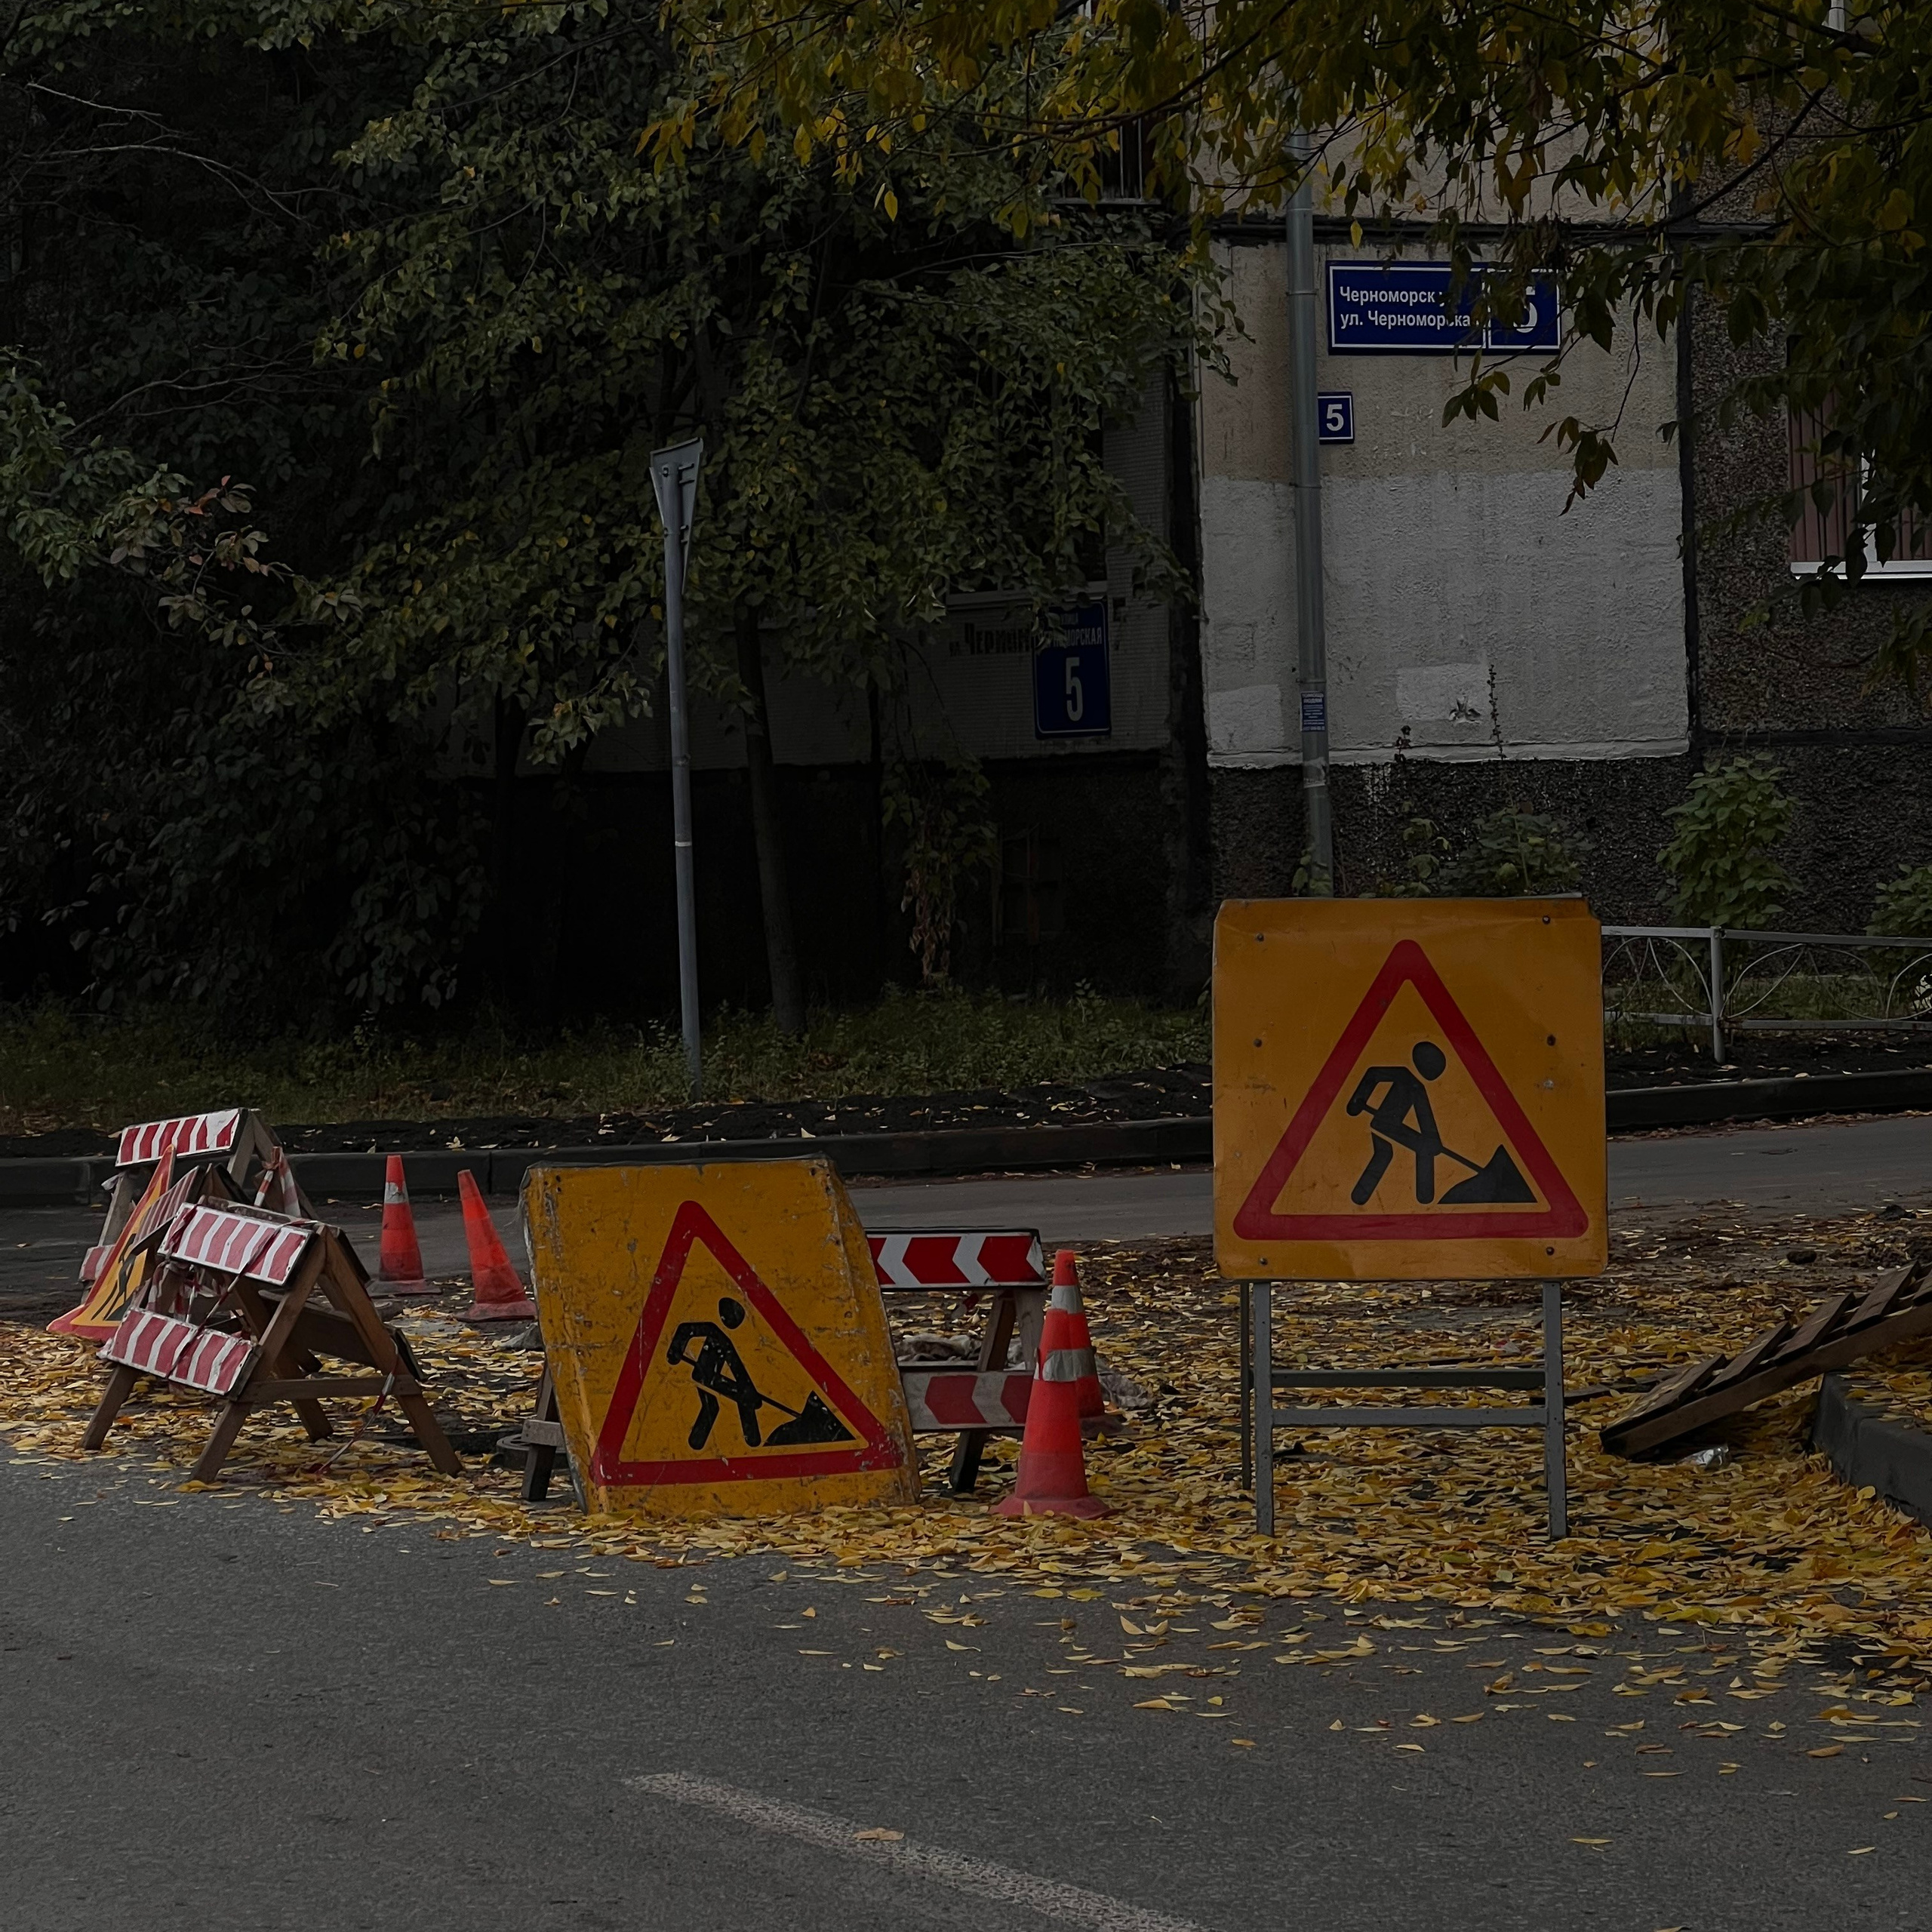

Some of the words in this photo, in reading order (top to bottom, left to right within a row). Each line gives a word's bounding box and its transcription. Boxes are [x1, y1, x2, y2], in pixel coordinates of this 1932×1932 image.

[1340, 285, 1435, 306] Черноморск
[1340, 313, 1363, 329] ул.
[1367, 310, 1480, 330] Черноморка
[1326, 403, 1344, 432] 5
[1065, 656, 1084, 722] 5
